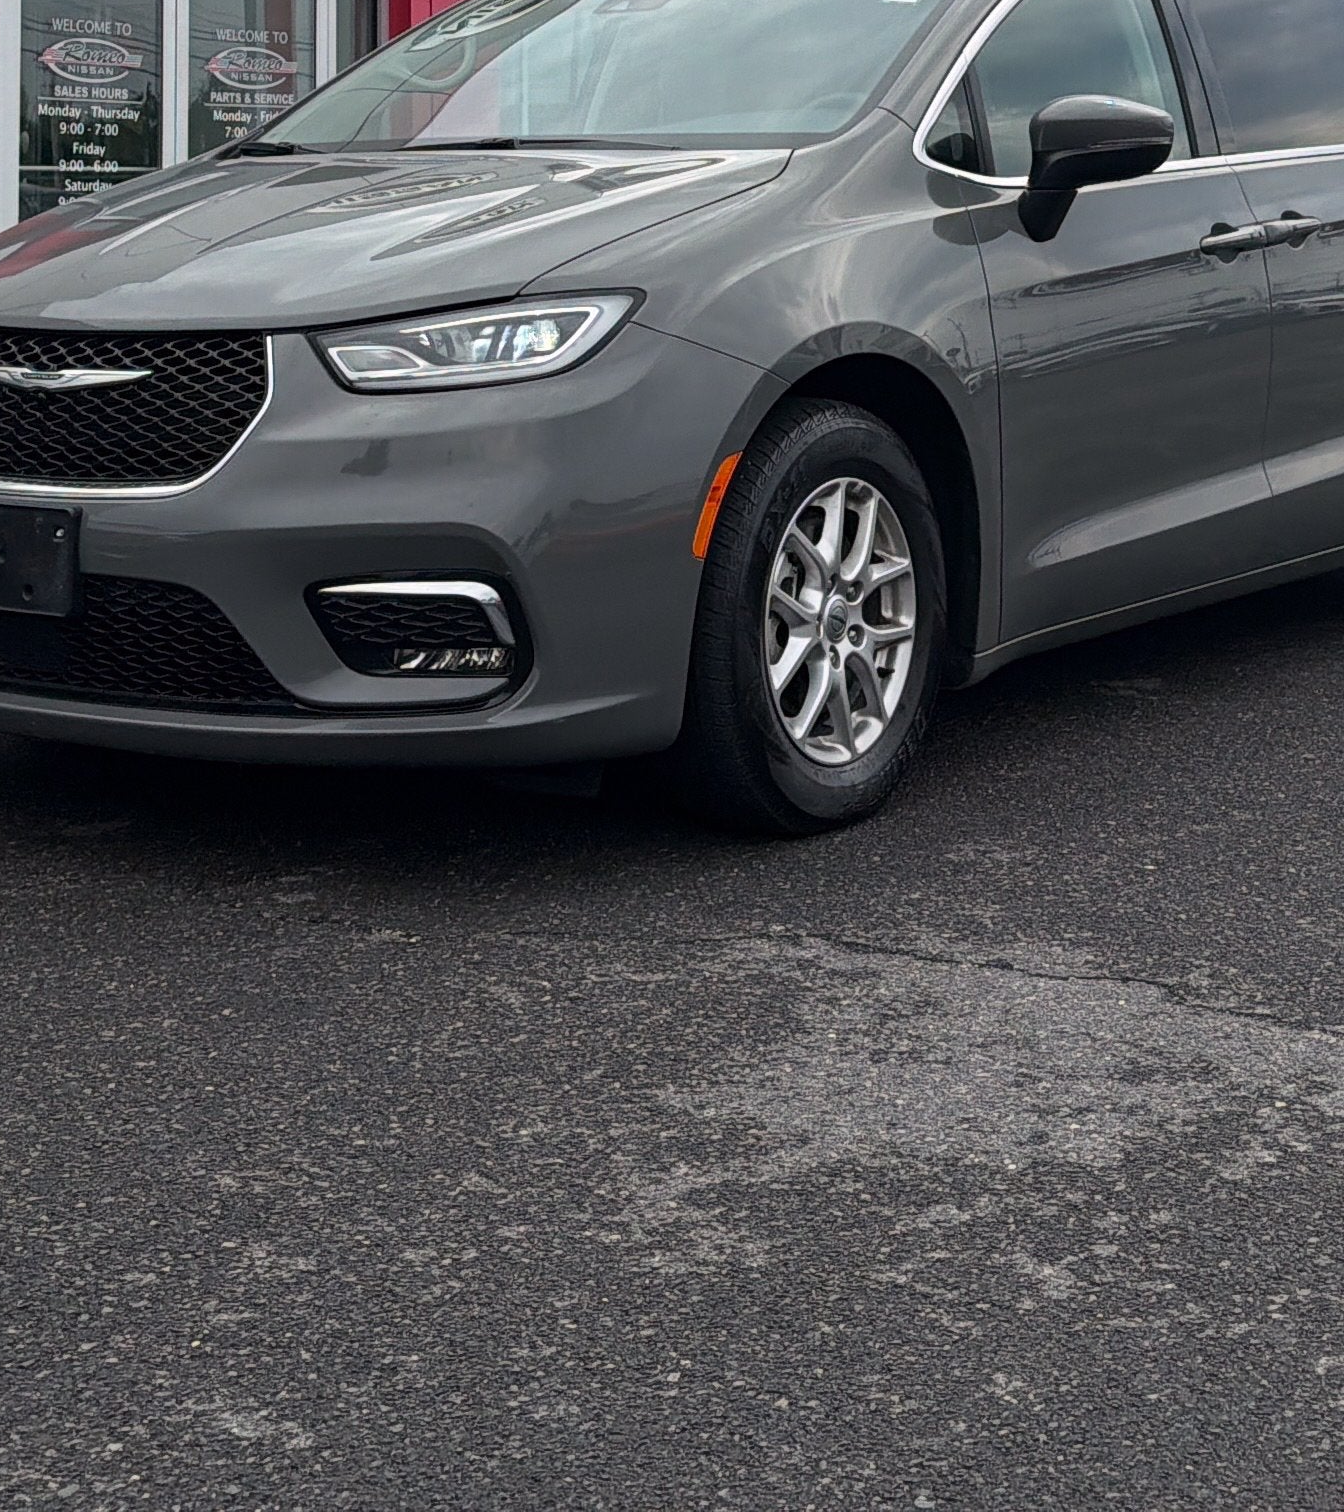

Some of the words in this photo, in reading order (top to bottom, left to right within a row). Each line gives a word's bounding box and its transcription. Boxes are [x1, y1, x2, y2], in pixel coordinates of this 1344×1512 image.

[52, 17, 113, 34] WELCOME
[116, 22, 132, 36] TO
[216, 29, 270, 43] WELCOME
[272, 31, 288, 44] TO
[59, 41, 128, 65] Romeo
[226, 50, 285, 73] Romeo
[67, 64, 114, 76] NISSAN
[231, 72, 273, 82] NISSAN
[54, 85, 89, 98] SALES
[91, 87, 129, 100] HOURS
[210, 91, 241, 103] PARTS
[244, 92, 251, 104] &
[254, 93, 295, 105] SERVICE
[38, 103, 81, 119] Monday
[91, 105, 141, 122] Thursday
[213, 109, 252, 124] Monday
[59, 122, 85, 135] 9:00
[94, 123, 119, 136] 7:00
[72, 142, 106, 157] Friday
[58, 159, 84, 172] 9:00
[93, 160, 119, 173] 6:00
